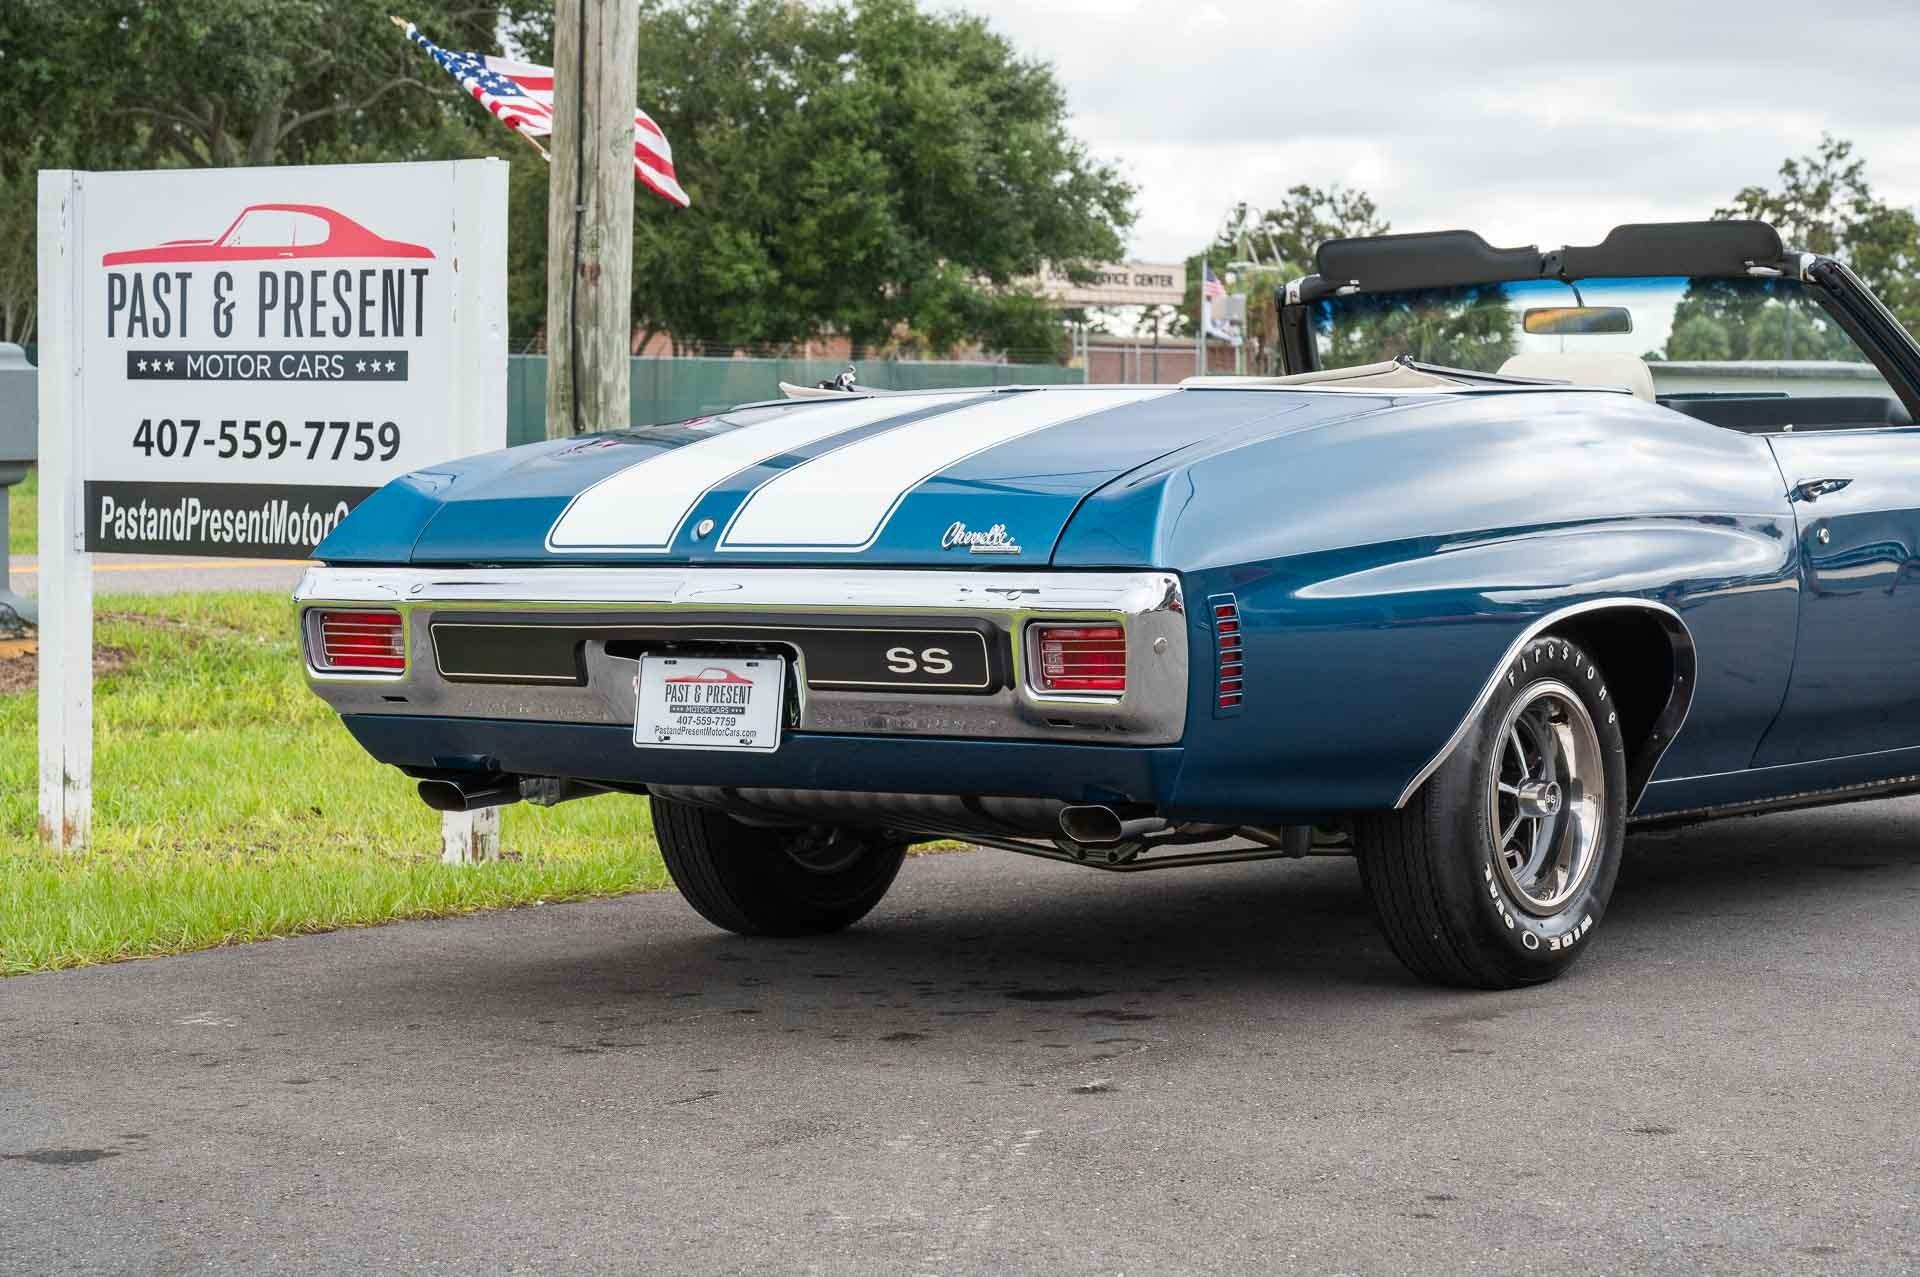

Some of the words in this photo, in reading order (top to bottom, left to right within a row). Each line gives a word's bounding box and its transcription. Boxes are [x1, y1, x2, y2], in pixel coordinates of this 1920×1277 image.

[1134, 273, 1174, 288] CENTER
[106, 270, 193, 338] PAST
[213, 271, 235, 339] &
[258, 268, 430, 338] PRESENT
[186, 354, 271, 378] MOTOR
[279, 354, 345, 378] CARS
[132, 418, 401, 462] 407-559-7759
[885, 647, 953, 674] SS
[665, 684, 691, 702] PAST
[694, 684, 702, 703] &
[706, 685, 752, 704] PRESENT
[686, 705, 710, 713] MOTOR
[711, 706, 729, 714] CARS
[676, 716, 736, 726] 407-559-7759
[654, 725, 757, 738] PastandPresentMotorCars.com
